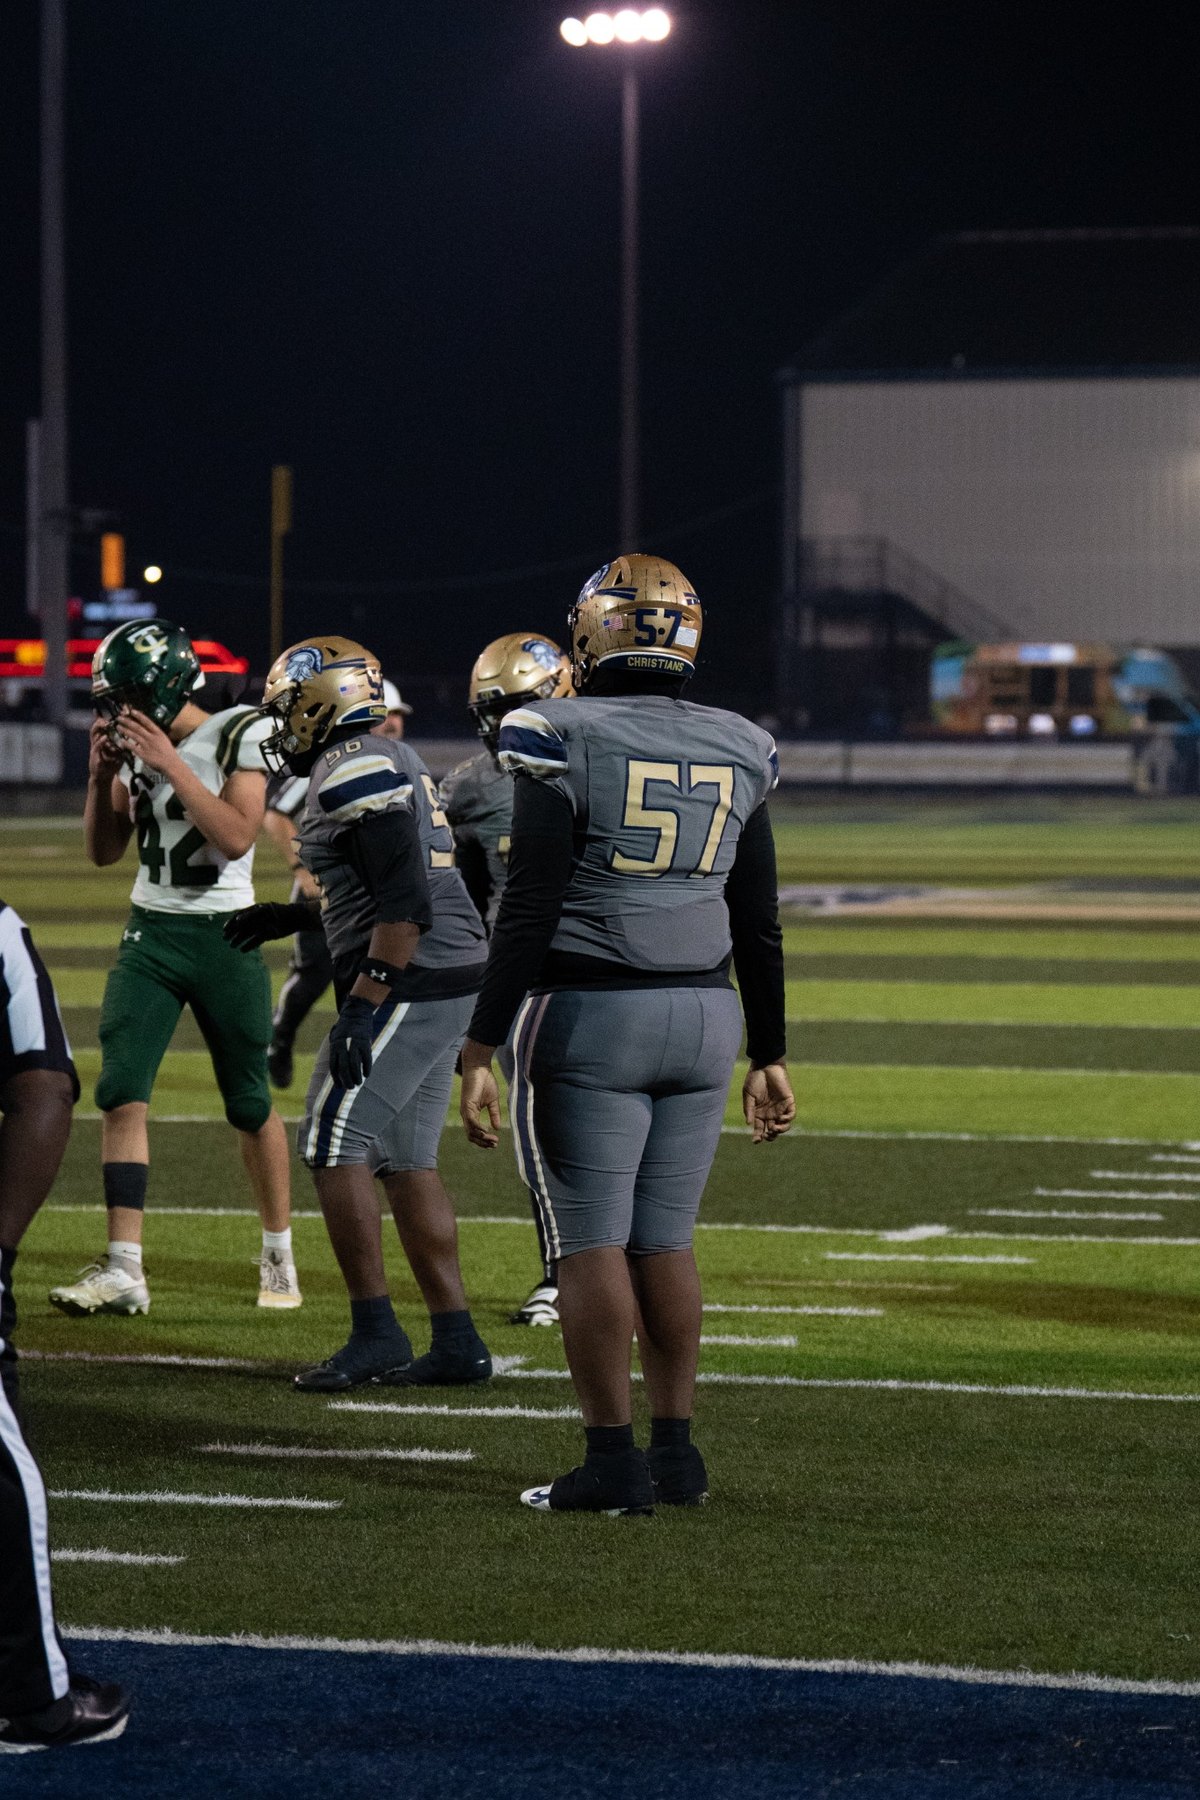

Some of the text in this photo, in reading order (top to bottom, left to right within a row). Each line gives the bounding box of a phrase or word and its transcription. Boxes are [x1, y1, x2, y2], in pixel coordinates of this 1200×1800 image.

[635, 609, 682, 648] 57
[627, 656, 685, 673] CHRISTIANS
[325, 739, 363, 769] 56
[138, 789, 219, 886] 42
[610, 757, 736, 879] 57
